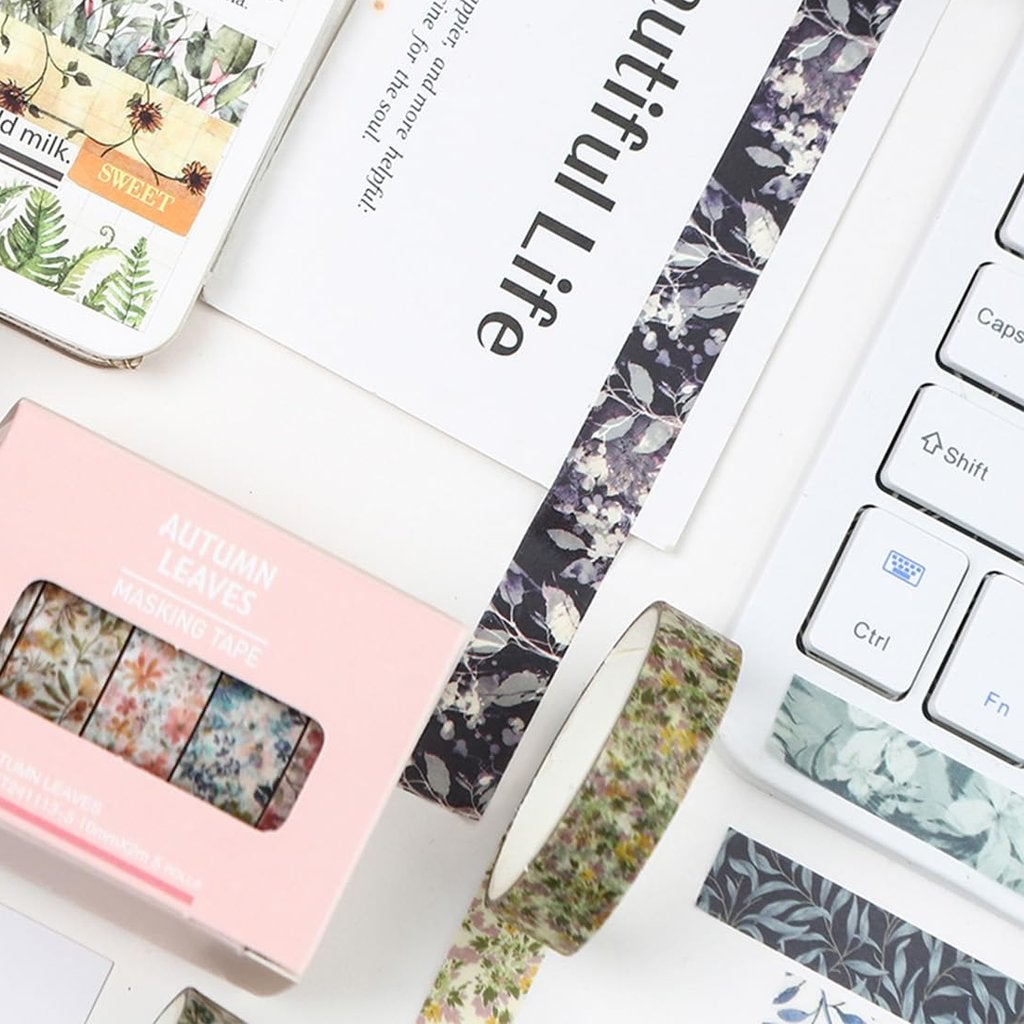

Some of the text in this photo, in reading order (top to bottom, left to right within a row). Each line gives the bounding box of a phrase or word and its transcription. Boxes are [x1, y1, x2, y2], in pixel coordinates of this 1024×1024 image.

[421, 56, 445, 96] and
[396, 92, 427, 140] more
[19, 127, 70, 164] milk.
[97, 162, 175, 212] SWEET
[476, 210, 596, 356] Life
[977, 307, 1024, 344] Caps
[943, 446, 989, 482] Shift
[158, 513, 278, 590] AUTUMN
[157, 547, 258, 615] LEAVES
[111, 577, 263, 669] MASKING TAPE
[853, 621, 891, 652] Ctrl
[983, 691, 1010, 717] Fn
